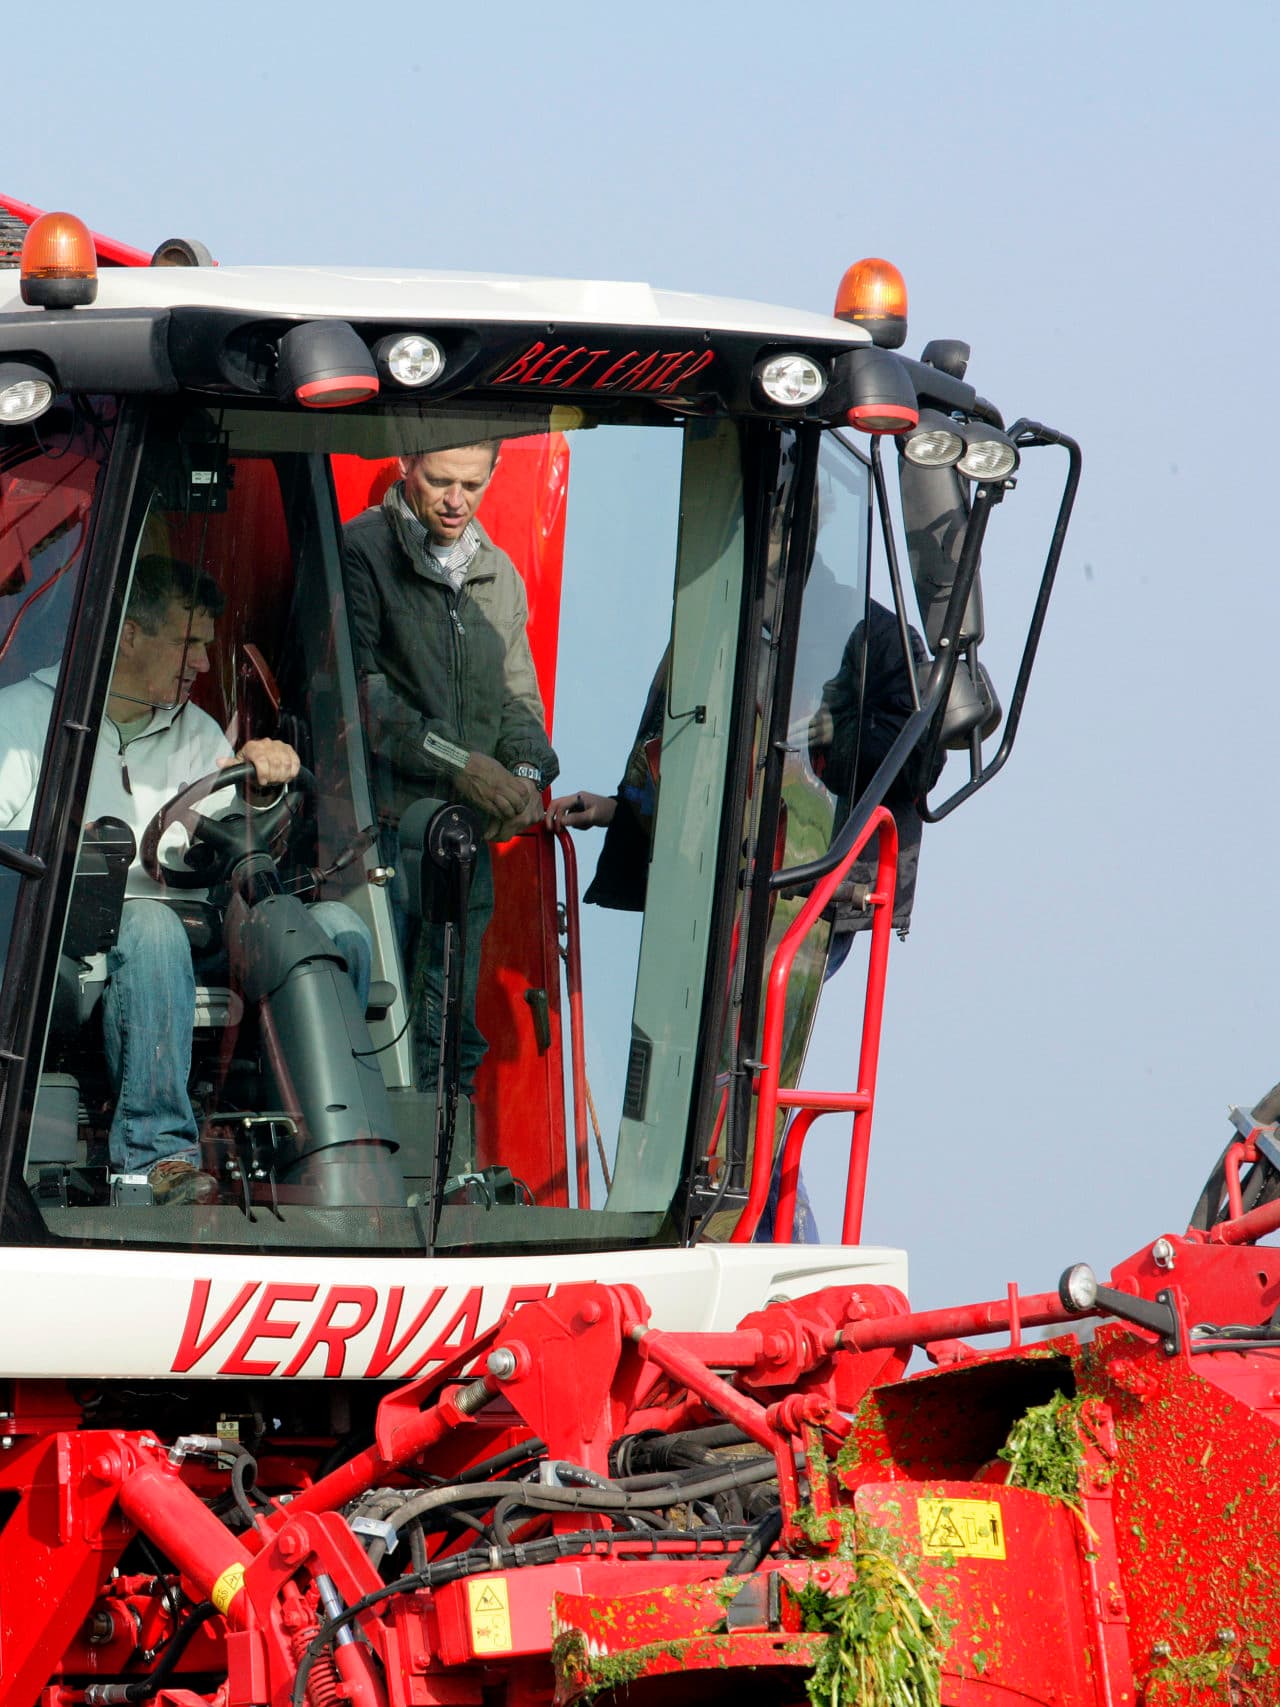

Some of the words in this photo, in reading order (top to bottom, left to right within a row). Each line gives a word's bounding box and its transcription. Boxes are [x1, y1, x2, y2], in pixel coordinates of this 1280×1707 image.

[489, 340, 611, 388] BEET
[591, 349, 716, 394] EATER
[170, 1278, 597, 1379] VERVA
